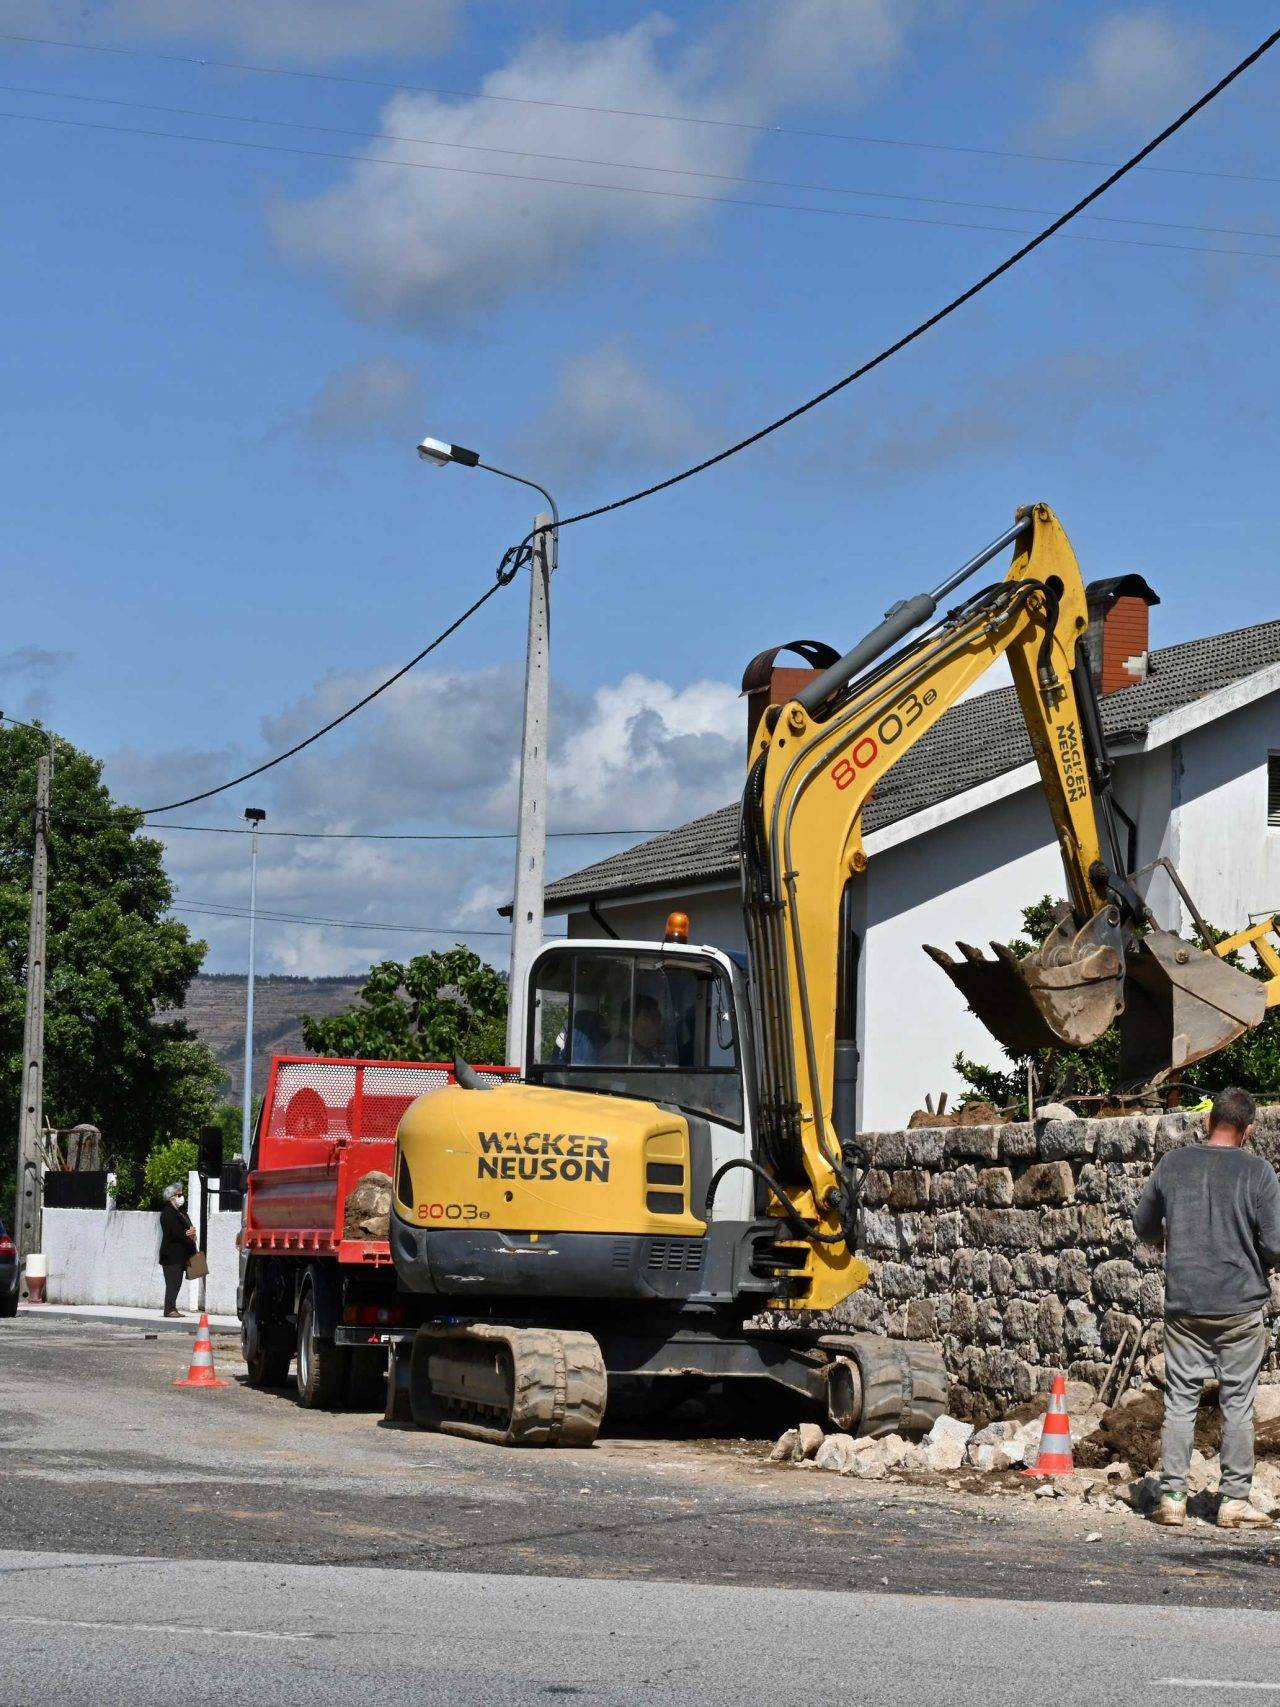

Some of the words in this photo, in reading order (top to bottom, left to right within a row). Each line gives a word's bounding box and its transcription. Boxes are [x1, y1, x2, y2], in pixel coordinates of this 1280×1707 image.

[1056, 725, 1079, 803] NEUSON
[478, 1131, 610, 1159] WACKER
[477, 1156, 610, 1182] NEUSON
